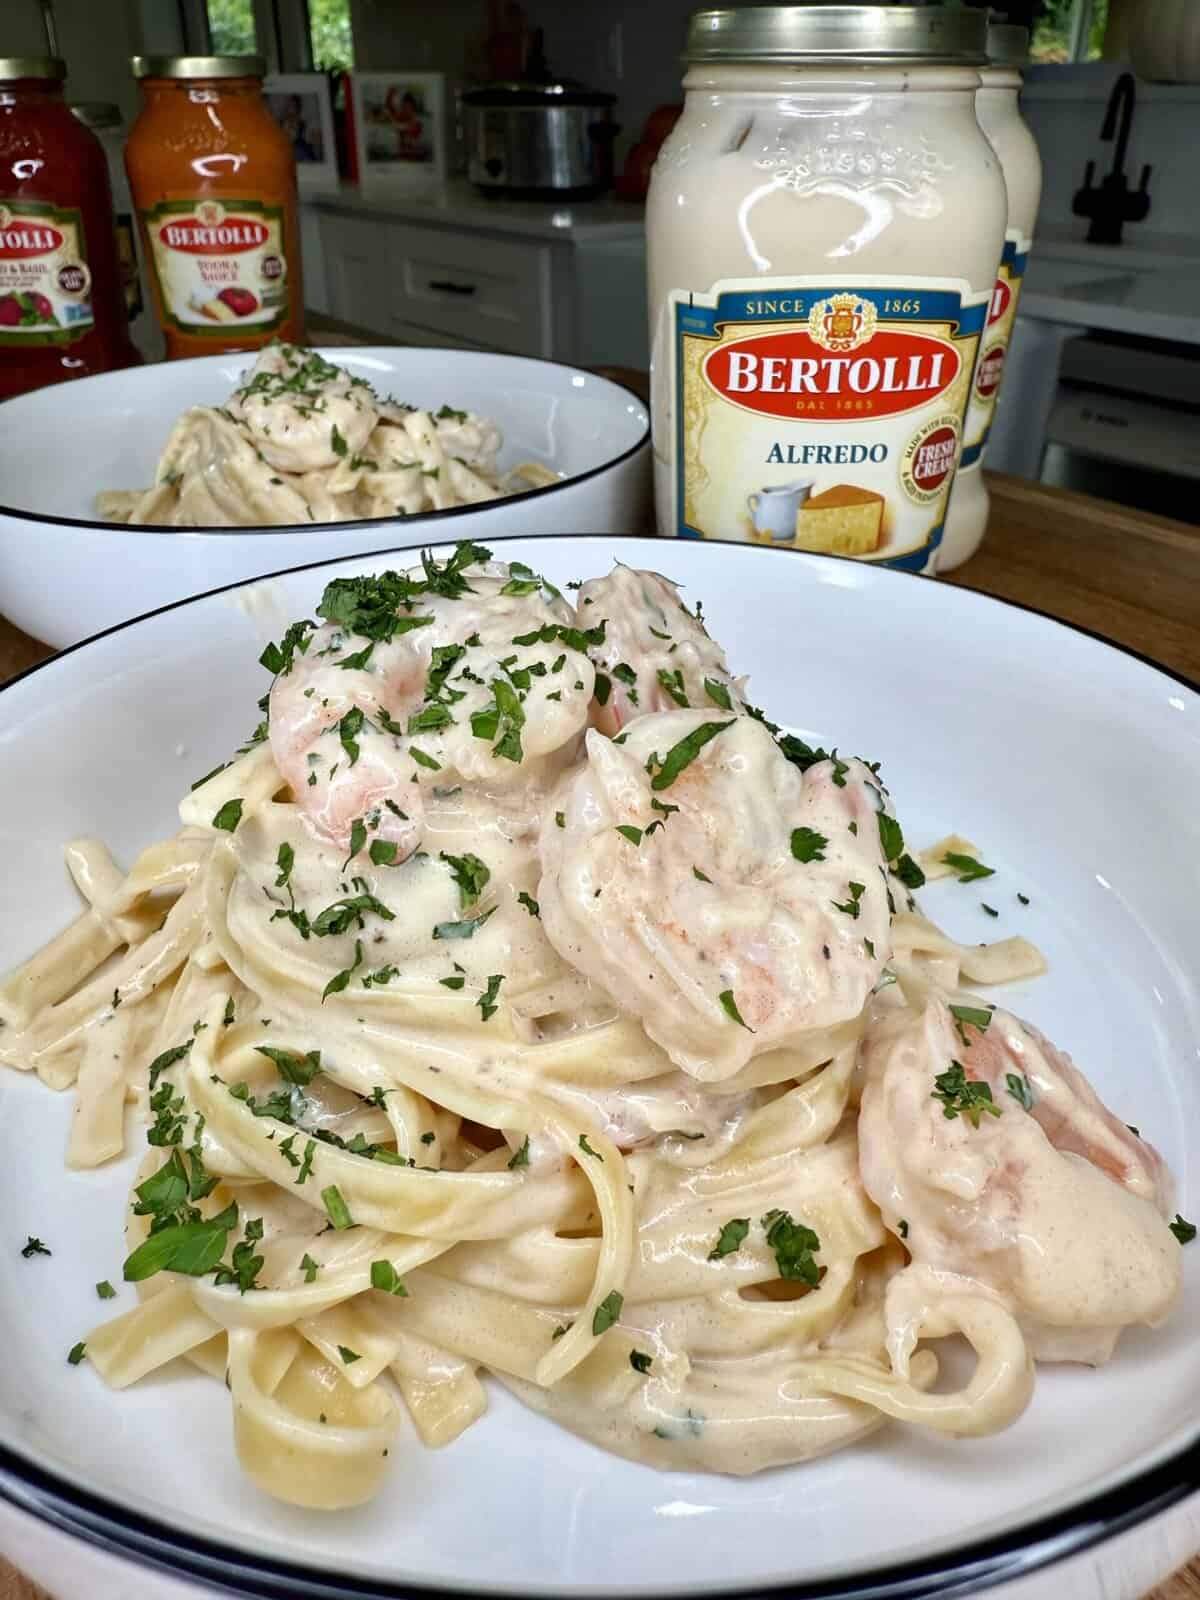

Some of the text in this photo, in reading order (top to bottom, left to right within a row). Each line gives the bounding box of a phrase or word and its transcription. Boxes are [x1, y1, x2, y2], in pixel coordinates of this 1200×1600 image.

[167, 225, 263, 246] BERTOLLI
[745, 299, 921, 315] SINCE 1865
[726, 351, 945, 394] BERTOLLI
[765, 442, 888, 464] ALFREDO
[919, 438, 955, 464] FRESH
